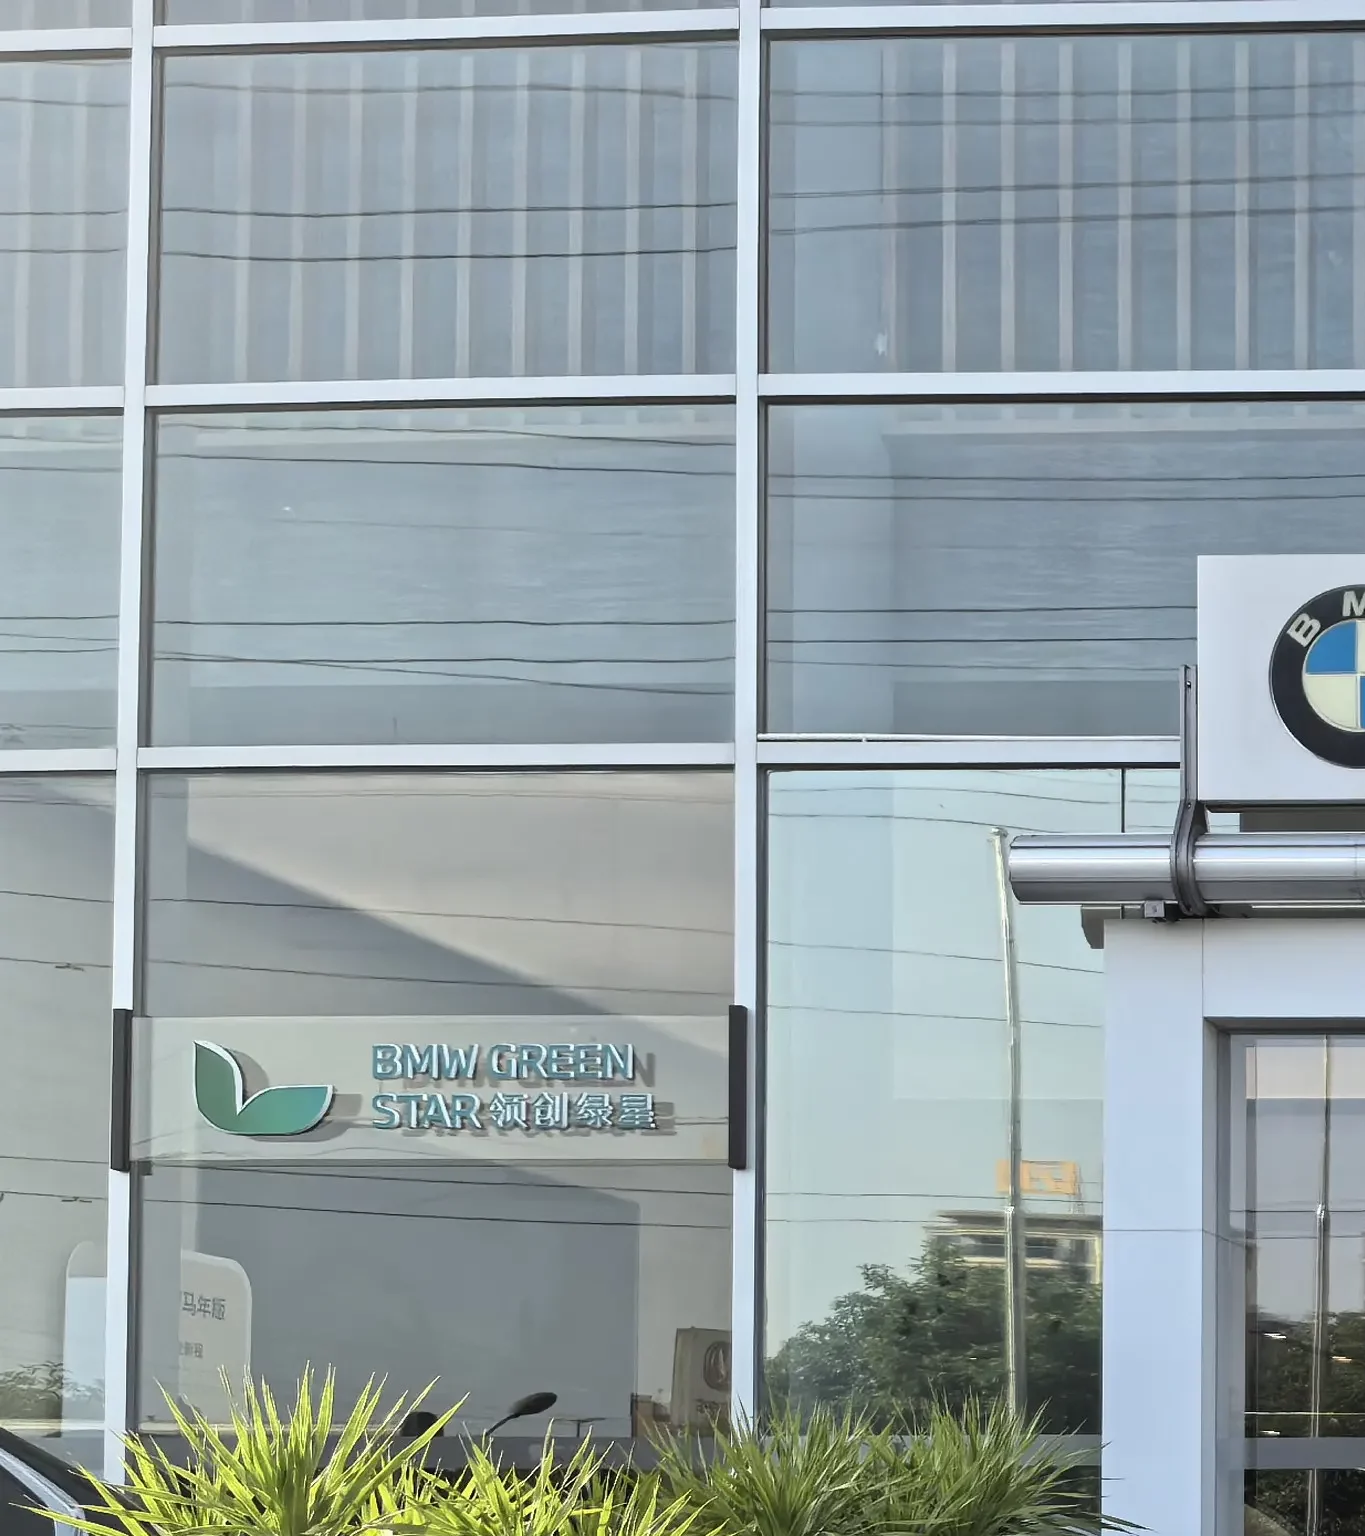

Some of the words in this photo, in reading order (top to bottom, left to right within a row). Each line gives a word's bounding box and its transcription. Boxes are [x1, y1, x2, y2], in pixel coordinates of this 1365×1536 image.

[372, 1043, 480, 1081] BMW
[488, 1043, 636, 1081] GREEN
[372, 1091, 482, 1129] STAR
[489, 1091, 658, 1130] 领创绿星
